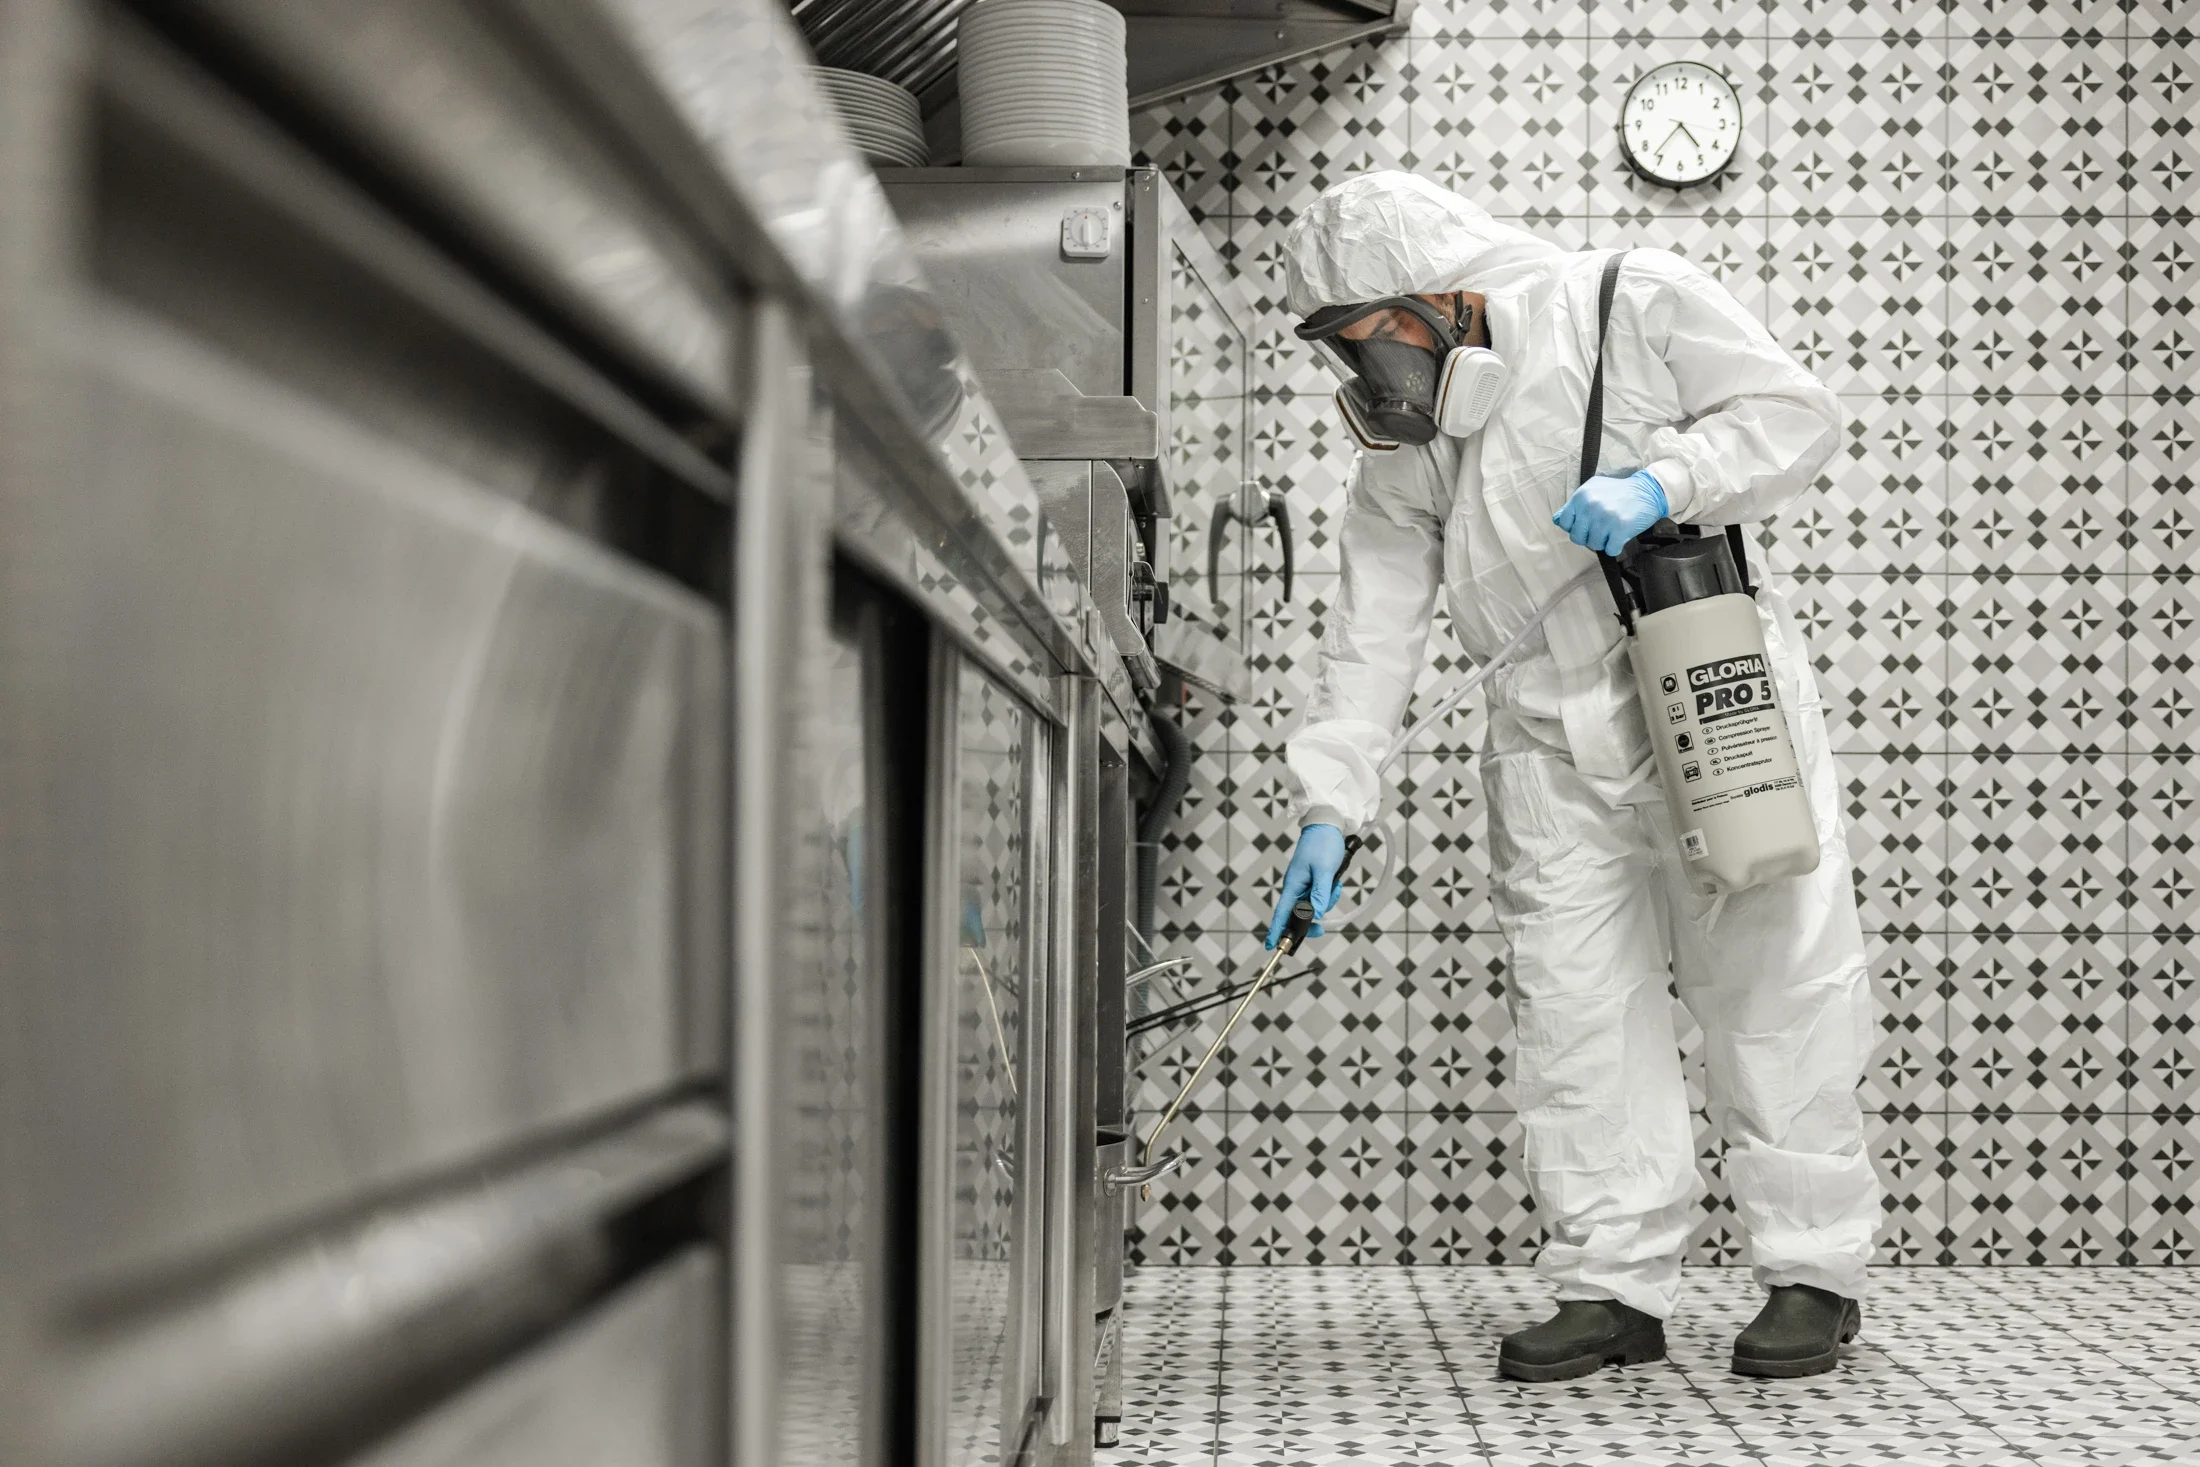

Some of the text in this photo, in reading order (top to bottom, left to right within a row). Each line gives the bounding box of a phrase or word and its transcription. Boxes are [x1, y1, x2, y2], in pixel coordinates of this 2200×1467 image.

[1656, 83, 1668, 95] 11
[1675, 77, 1688, 90] 12
[1699, 83, 1704, 95] 1
[1641, 99, 1654, 111] 10
[1712, 97, 1720, 109] 2
[1635, 119, 1642, 131] 9
[1719, 118, 1726, 130] 3
[1641, 140, 1649, 152] 8
[1711, 139, 1719, 150] 4
[1657, 154, 1664, 166] 7
[1676, 160, 1684, 172] 6
[1697, 154, 1704, 166] 5
[1690, 657, 1765, 686] GLORIA
[1696, 680, 1772, 716] PRO 5
[1719, 729, 1753, 741] Compression
[1721, 740, 1755, 751] Pulvérisateur
[1744, 783, 1773, 797] glodis
